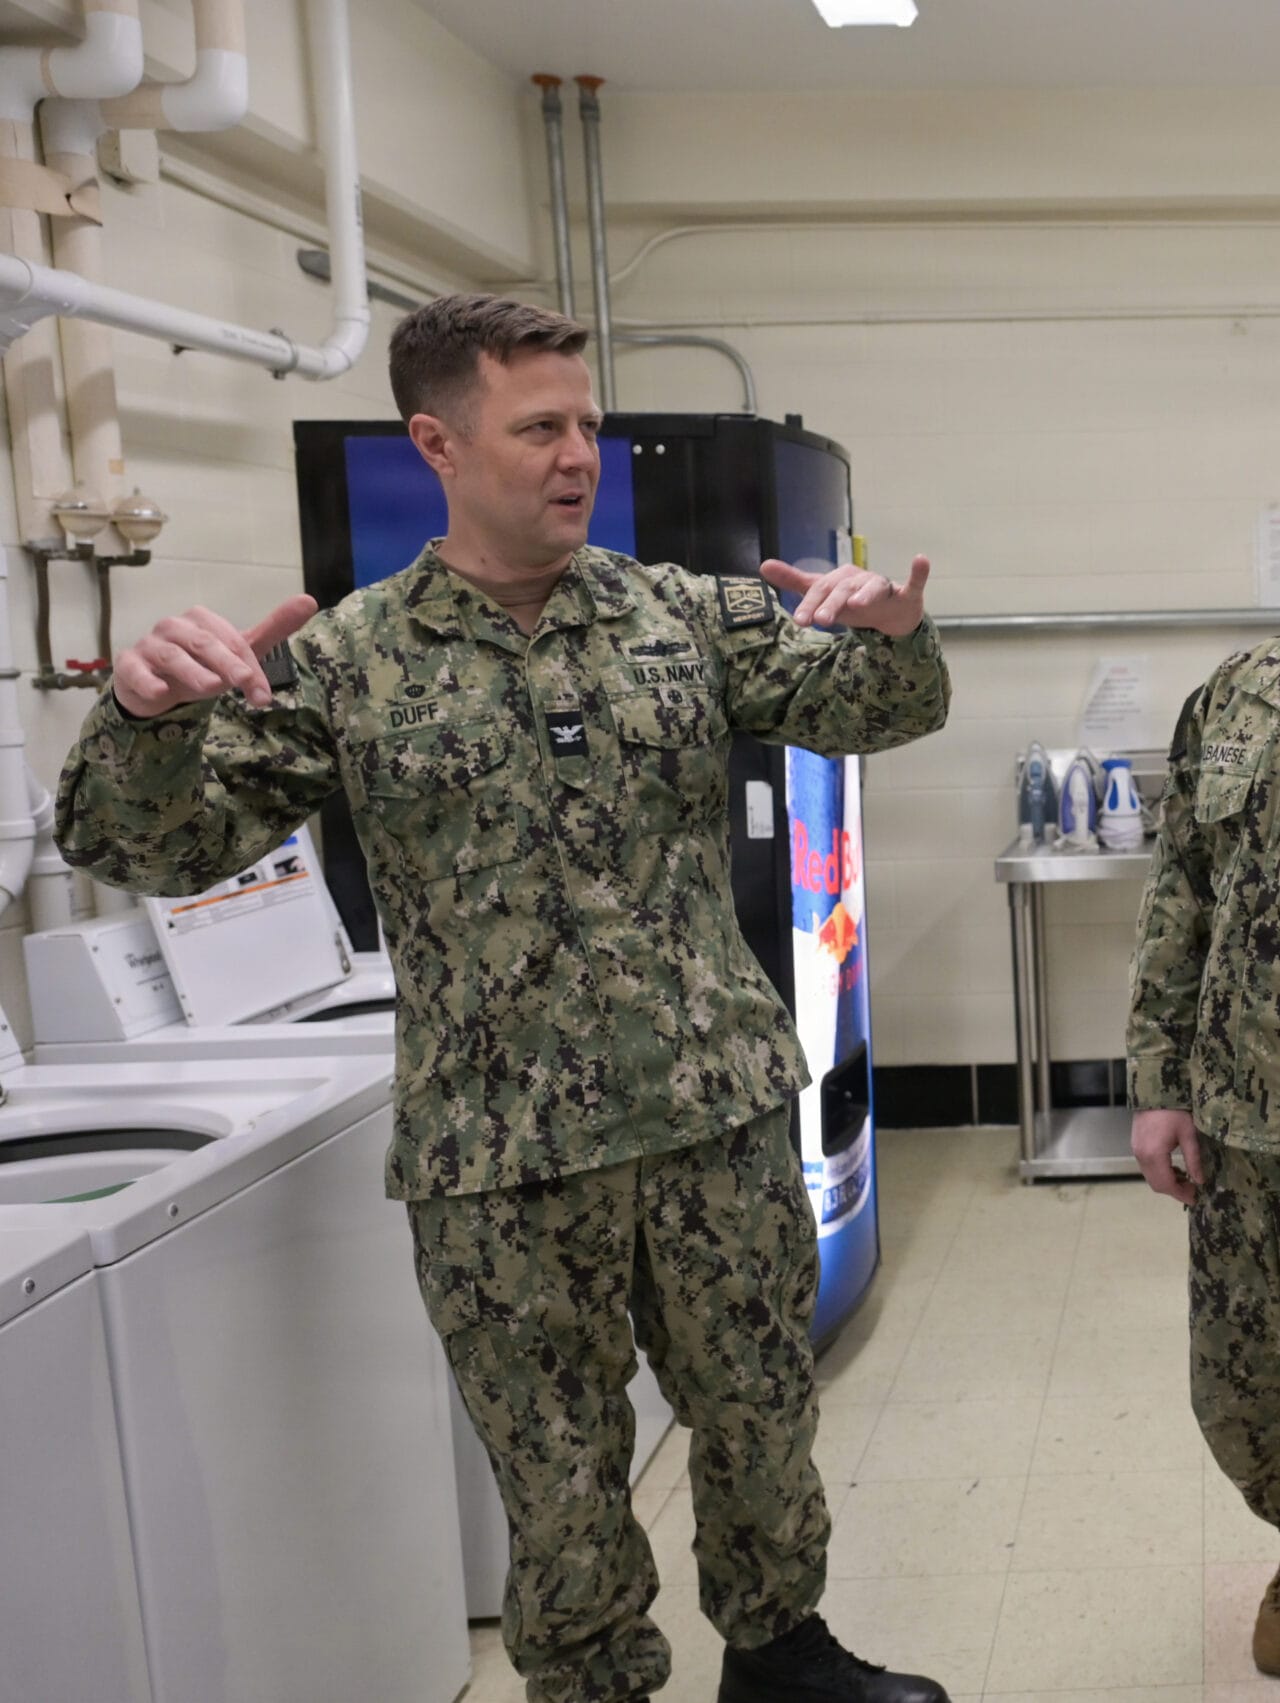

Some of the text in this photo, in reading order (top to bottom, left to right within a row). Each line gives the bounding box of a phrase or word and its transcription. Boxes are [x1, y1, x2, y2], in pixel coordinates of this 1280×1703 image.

[633, 664, 704, 685] U.S. NAVY
[390, 701, 438, 728] DUFF
[1201, 744, 1247, 765] LBANESE
[793, 818, 840, 895] Red
